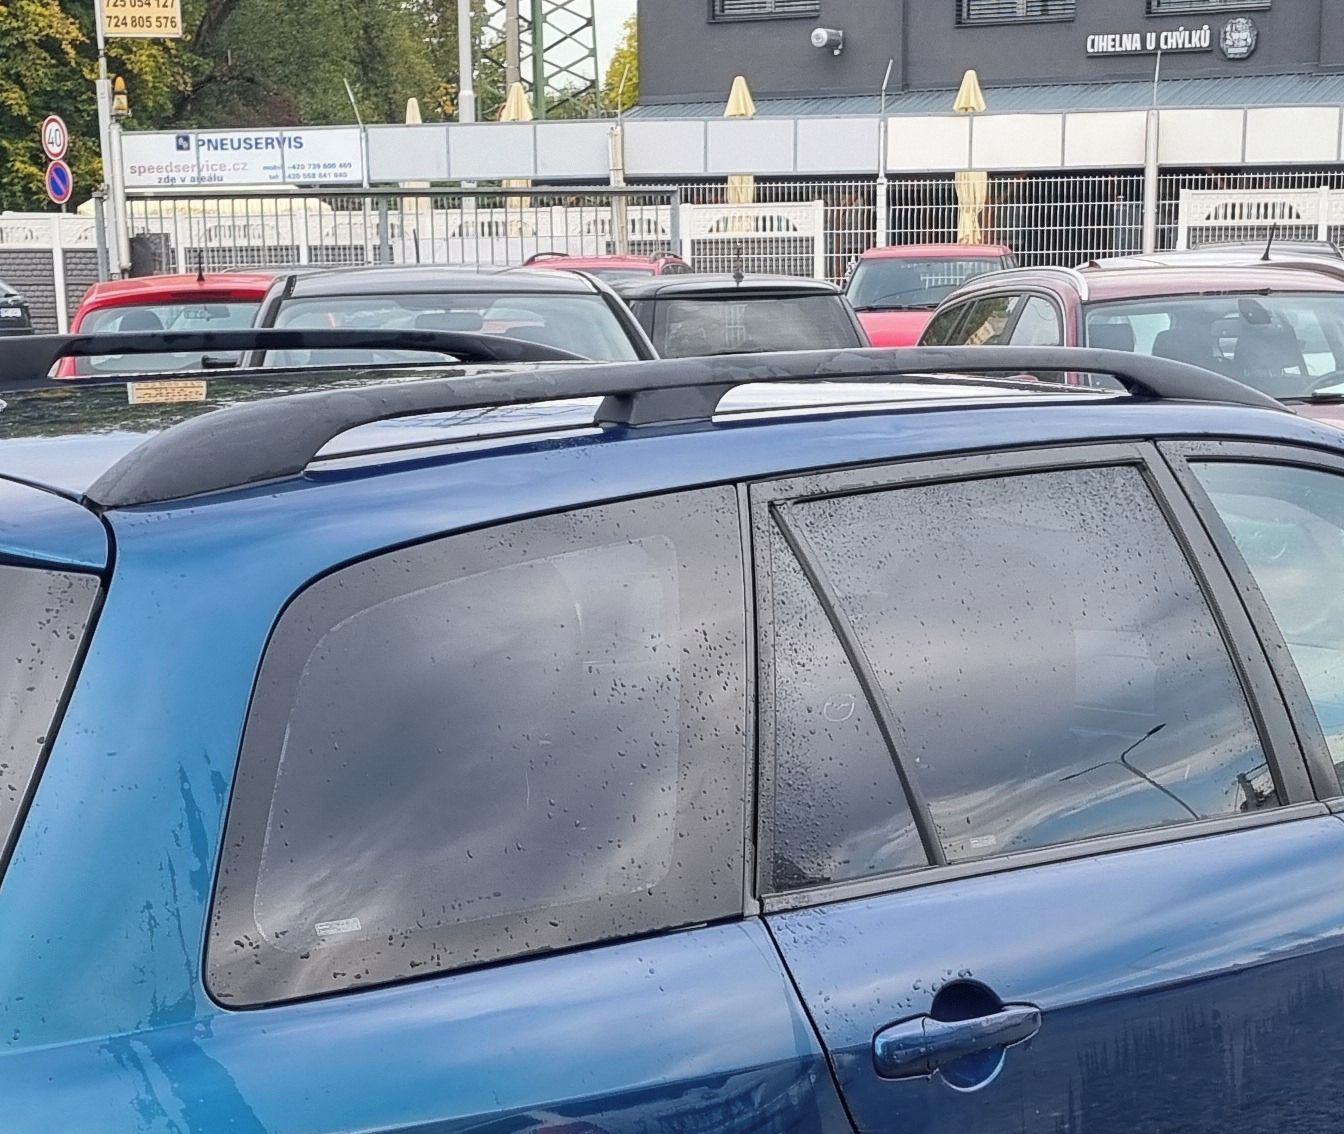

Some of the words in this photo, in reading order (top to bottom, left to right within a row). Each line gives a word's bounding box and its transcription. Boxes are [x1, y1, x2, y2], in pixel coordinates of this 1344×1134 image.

[106, 16, 127, 28] 724
[131, 16, 152, 28] 805
[155, 16, 177, 28] 576
[1086, 33, 1142, 52] CIHELNA
[1146, 33, 1156, 50] U
[1160, 25, 1211, 50] CHÝLKŮ
[48, 127, 62, 148] 40
[197, 136, 304, 151] PNEUSERVIS
[130, 160, 249, 177] speedservice.cz
[157, 174, 177, 184] zde
